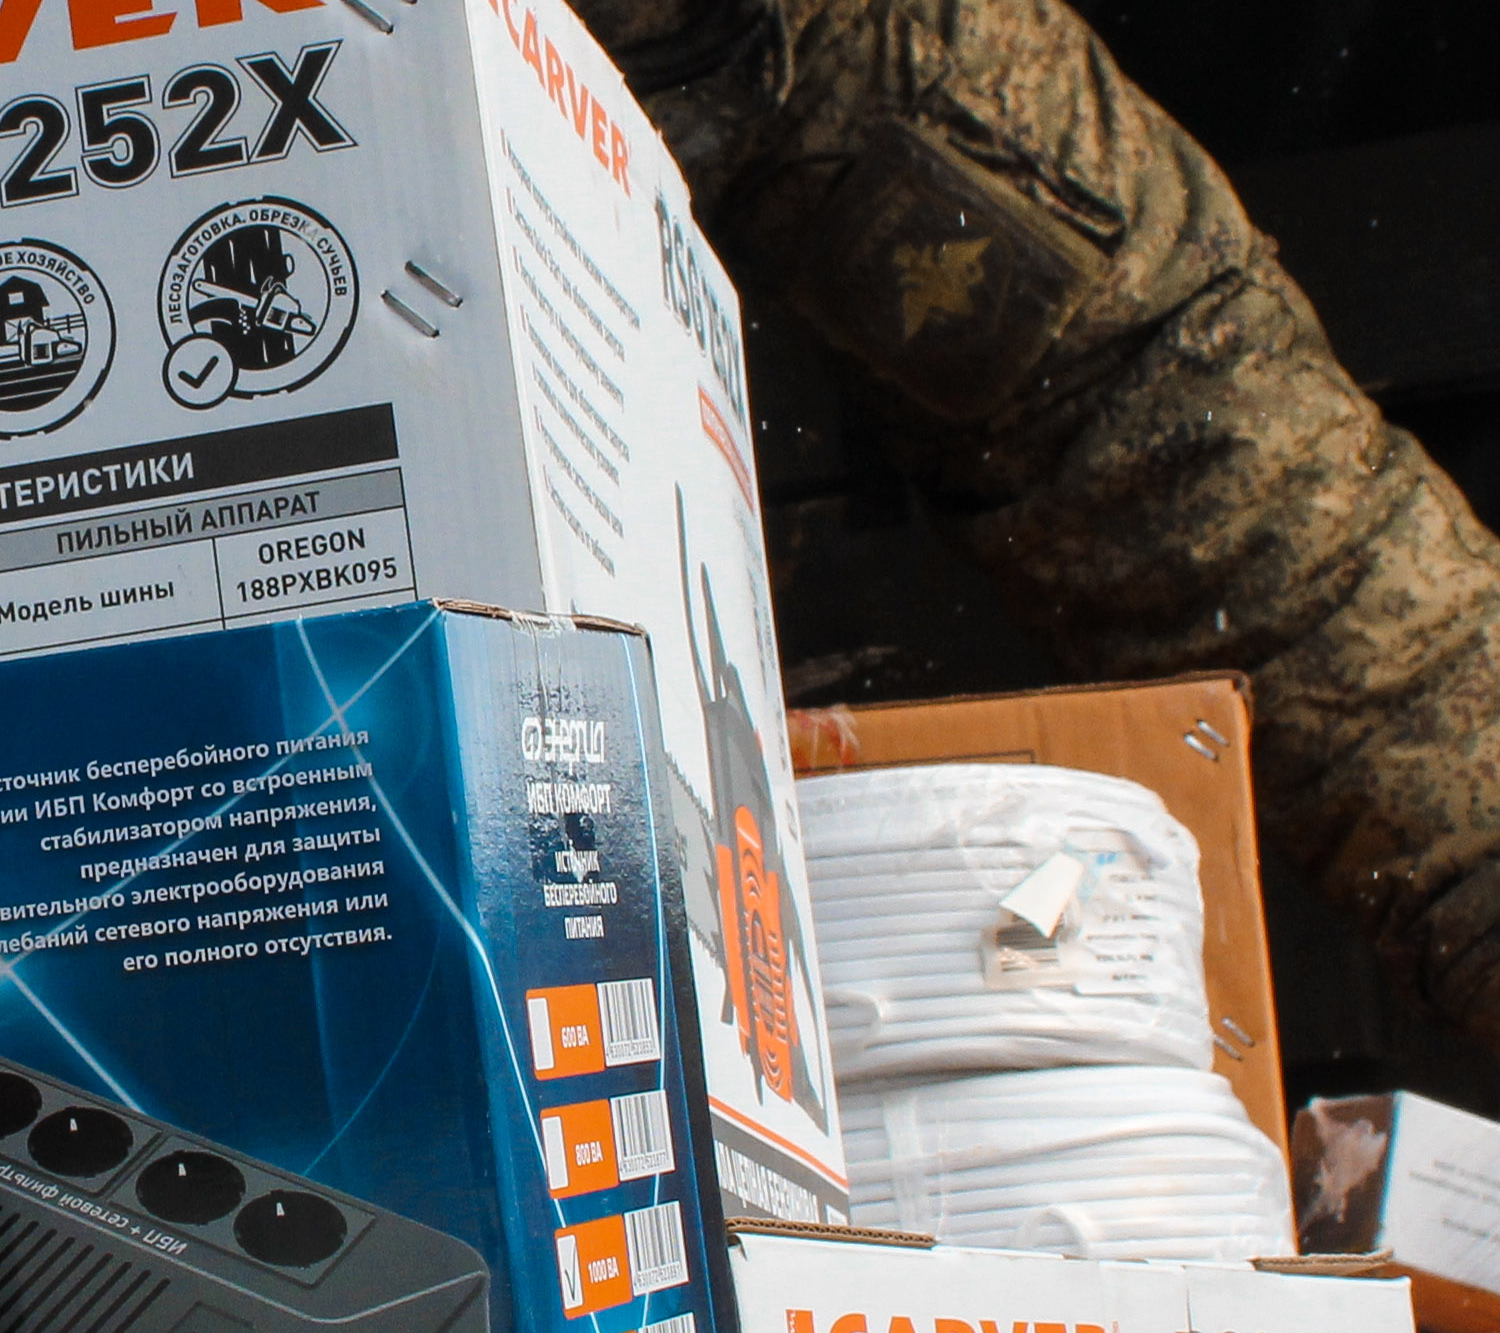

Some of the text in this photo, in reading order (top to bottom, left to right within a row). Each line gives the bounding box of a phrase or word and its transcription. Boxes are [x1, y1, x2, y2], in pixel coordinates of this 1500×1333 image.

[17, 251, 94, 305] ХОЗЯЙСТВО
[169, 209, 347, 324] ЛЕСОЗАГОТОВКА. ОБРЕЗКА СУЧЬЕВ
[56, 491, 320, 556] ПИЛЬНЫЙ АППАРАТ
[257, 527, 366, 566] OREGON
[101, 579, 175, 609] шины
[236, 556, 397, 604] 188PXBK095
[87, 740, 269, 780] бесперебойного
[276, 728, 369, 756] питания
[35, 796, 86, 820] ИБП
[93, 783, 194, 815] Комфорт
[201, 780, 225, 798] со
[233, 762, 372, 795] встроенным
[553, 784, 610, 814] КОМФОРТ
[40, 796, 376, 851] стабилизатором напряжения,
[80, 827, 381, 881] предназначен для защиты
[555, 850, 599, 873] ИСТОЧНИК
[132, 860, 385, 906] электрооборудования
[544, 879, 618, 907] БЕСПЕРЕБОЙНОГО
[95, 915, 190, 943] сетевого
[197, 898, 339, 932] напряжения
[346, 892, 388, 912] или
[564, 916, 603, 939] ПИТАНИЯ
[123, 925, 393, 973] его полного отсутствия.
[59, 1192, 130, 1232] сетевой
[143, 1230, 188, 1254] ИБП
